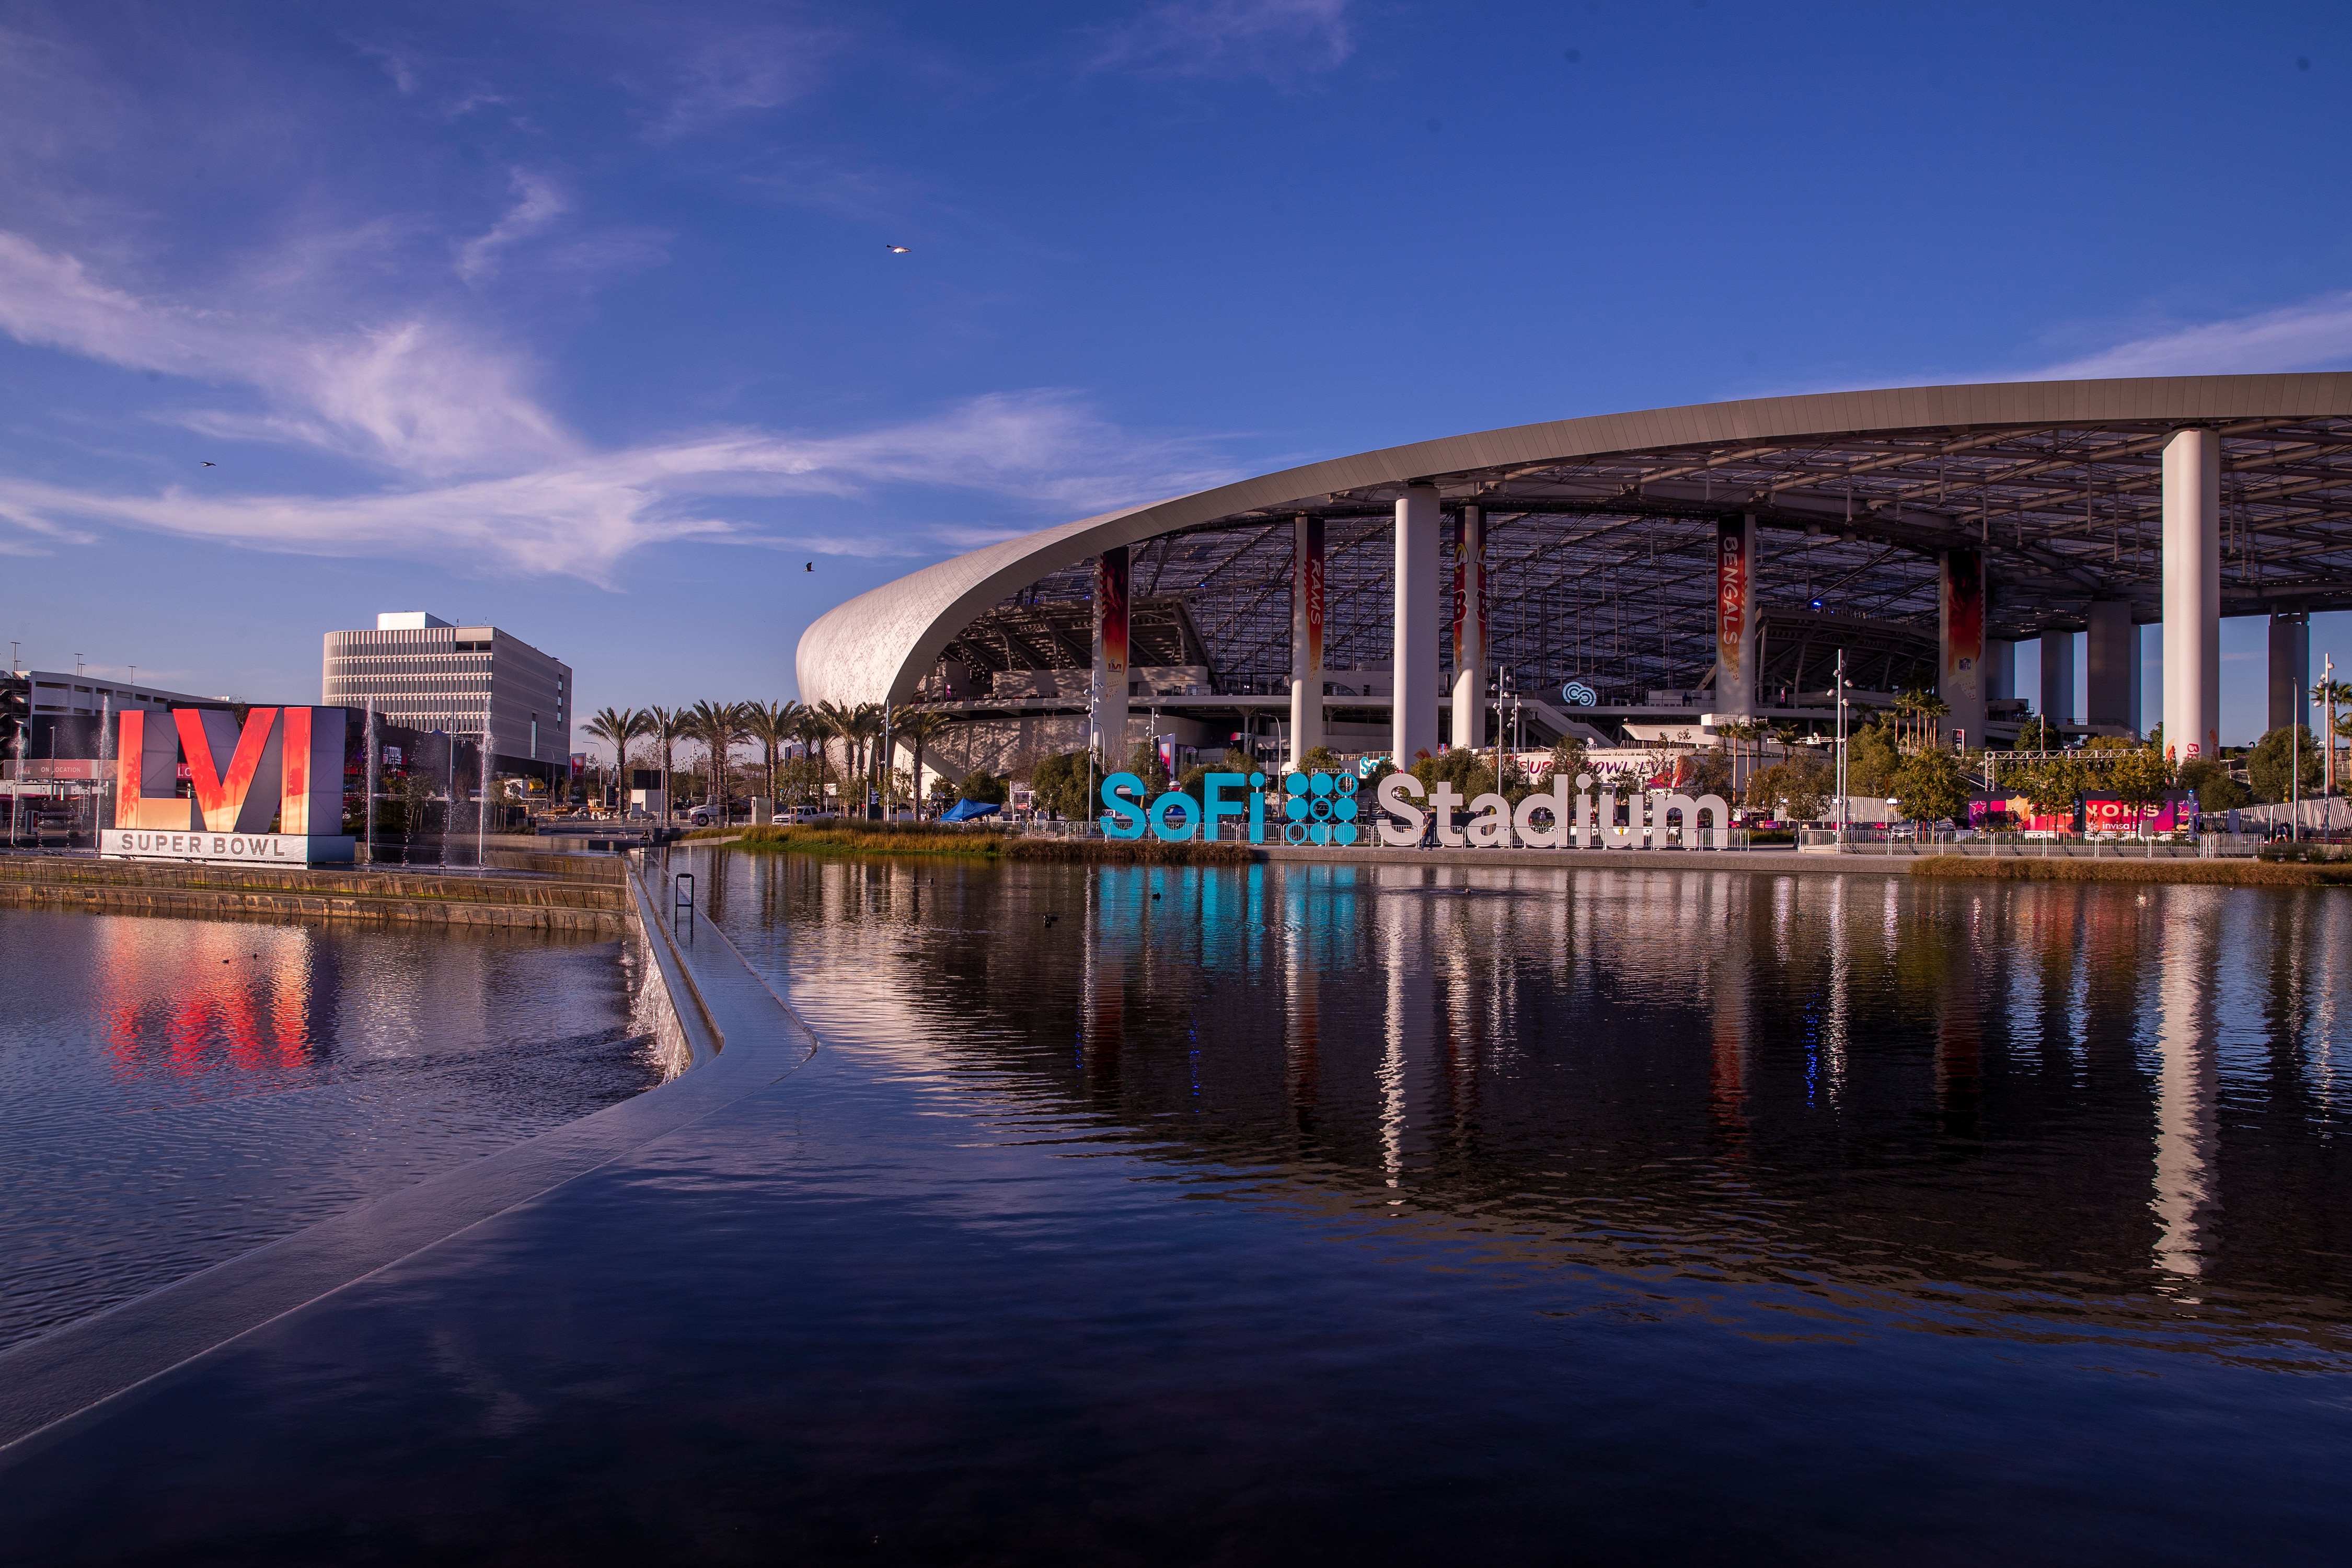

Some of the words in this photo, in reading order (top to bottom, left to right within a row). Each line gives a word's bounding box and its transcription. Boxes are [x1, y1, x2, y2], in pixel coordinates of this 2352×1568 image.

[1310, 558, 1322, 625] RAMS
[1723, 536, 1738, 645] BENGALS
[116, 707, 312, 835] LVI
[389, 746, 402, 758] TOTAL
[1361, 756, 1391, 775] So
[1100, 772, 1266, 844] SoFi
[1377, 774, 1729, 850] Stadium
[121, 833, 202, 854] SUPER
[213, 836, 287, 857] BOWL
